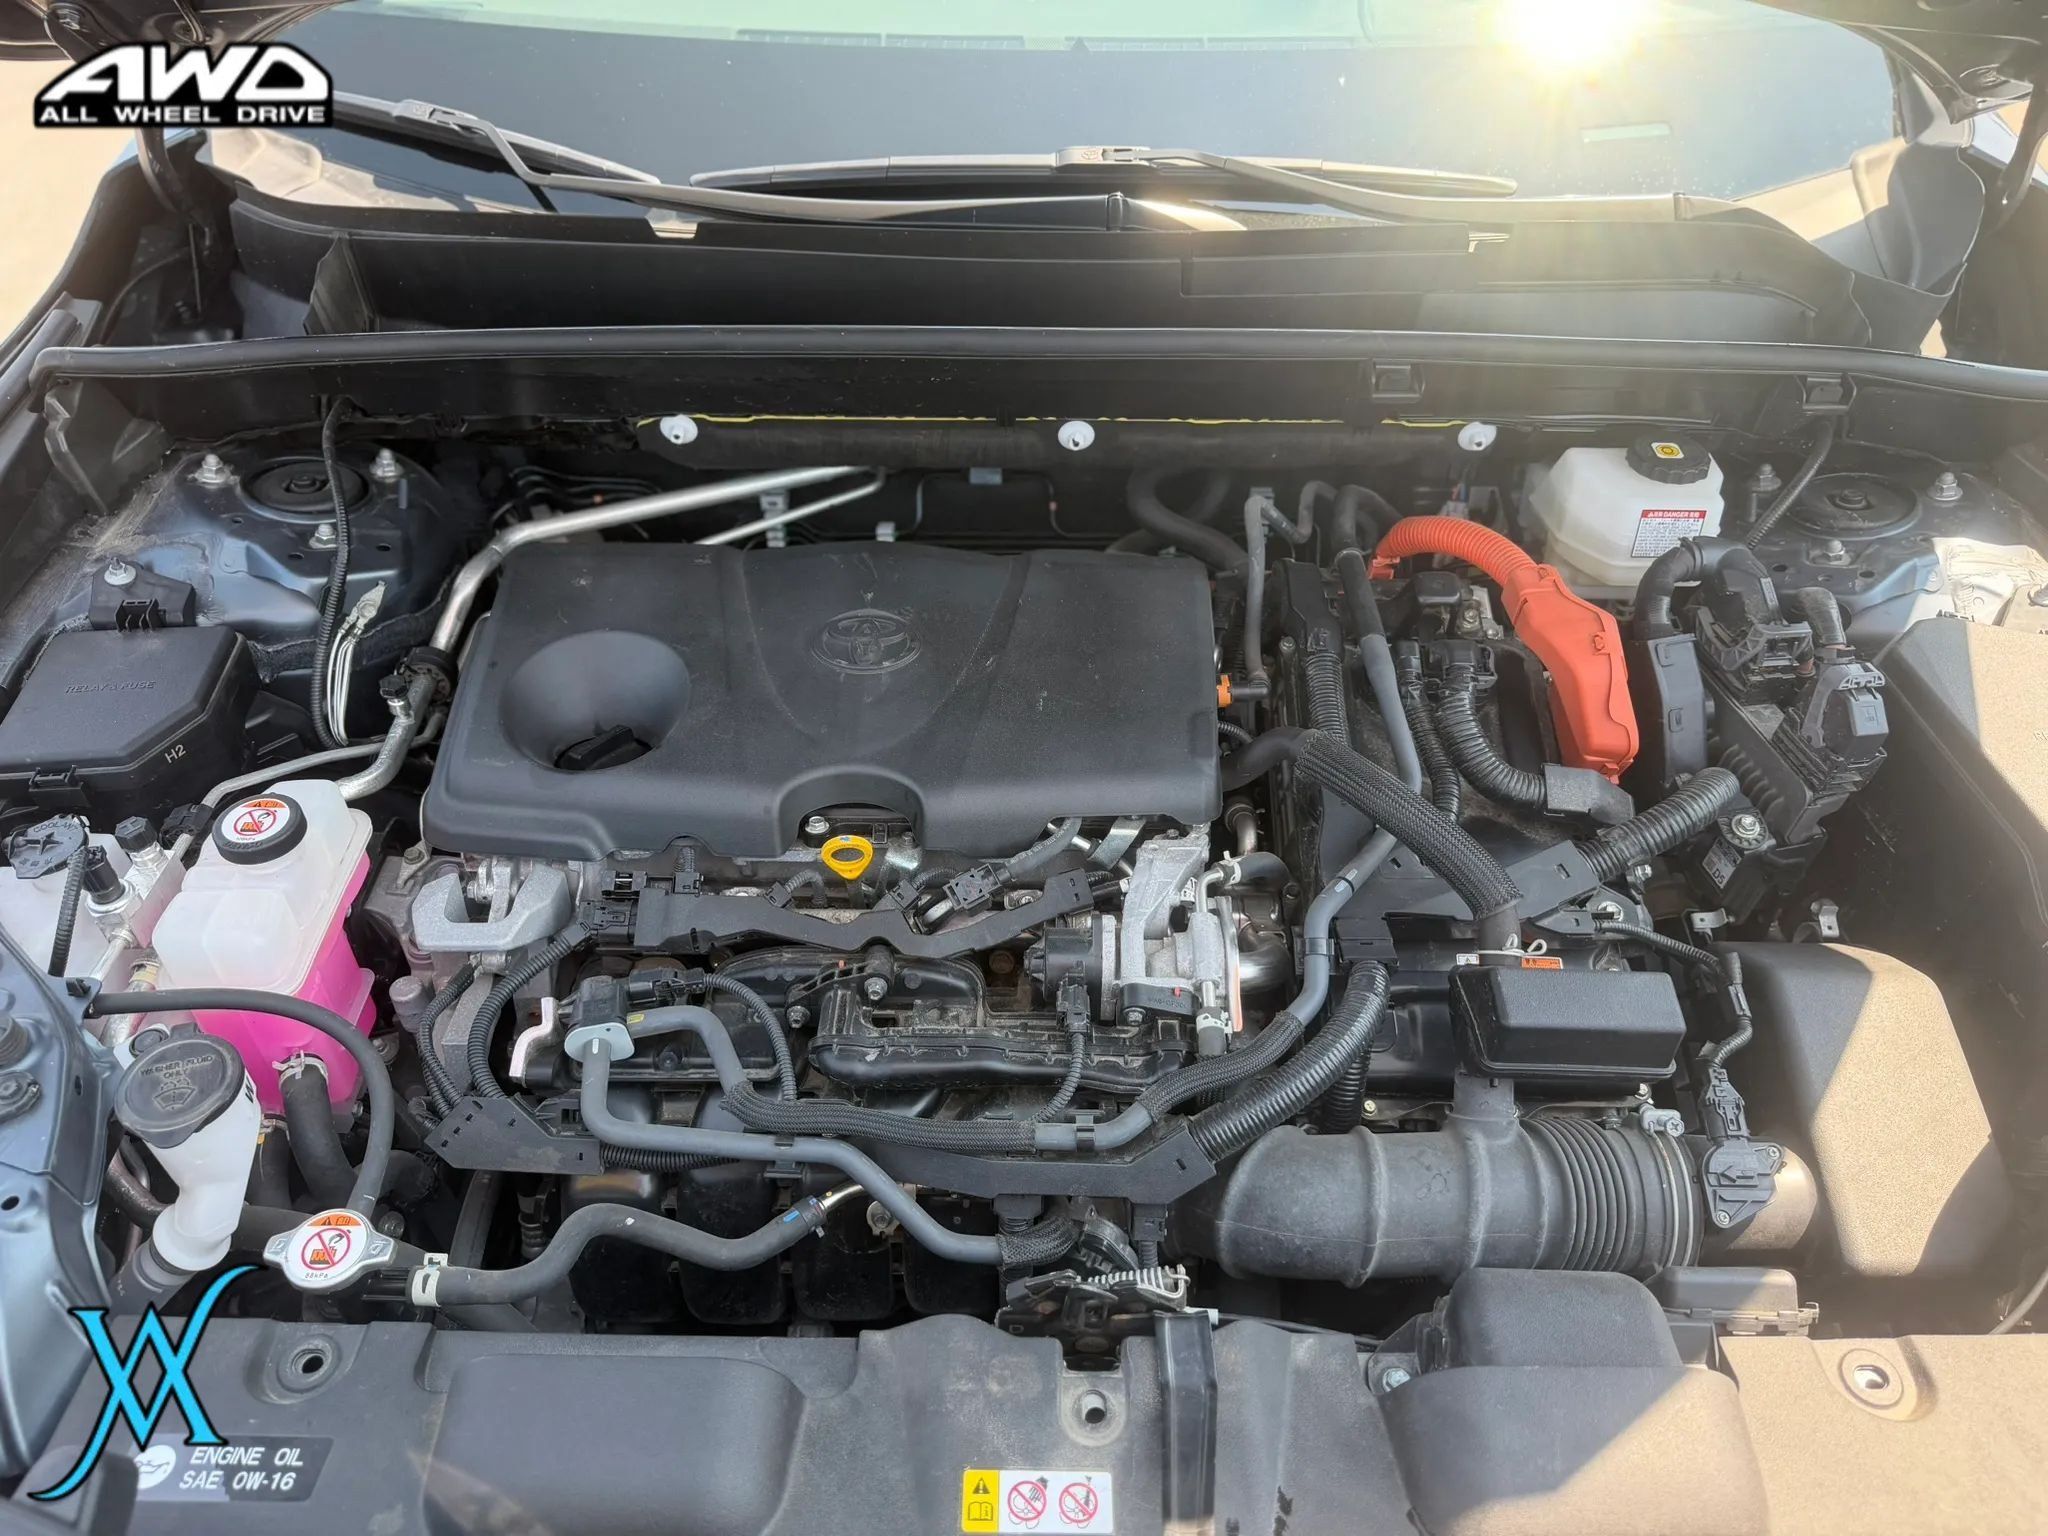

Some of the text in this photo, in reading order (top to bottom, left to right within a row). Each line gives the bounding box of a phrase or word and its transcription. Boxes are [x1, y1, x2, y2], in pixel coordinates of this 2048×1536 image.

[65, 682, 109, 694] RELAY
[120, 680, 157, 691] FUSE
[164, 744, 187, 764] H2
[140, 1055, 213, 1076] WASHER FLUID
[163, 1068, 189, 1079] ONLY
[189, 1446, 304, 1467] ENGINE OIL
[178, 1470, 297, 1491] SAE 0W-16
